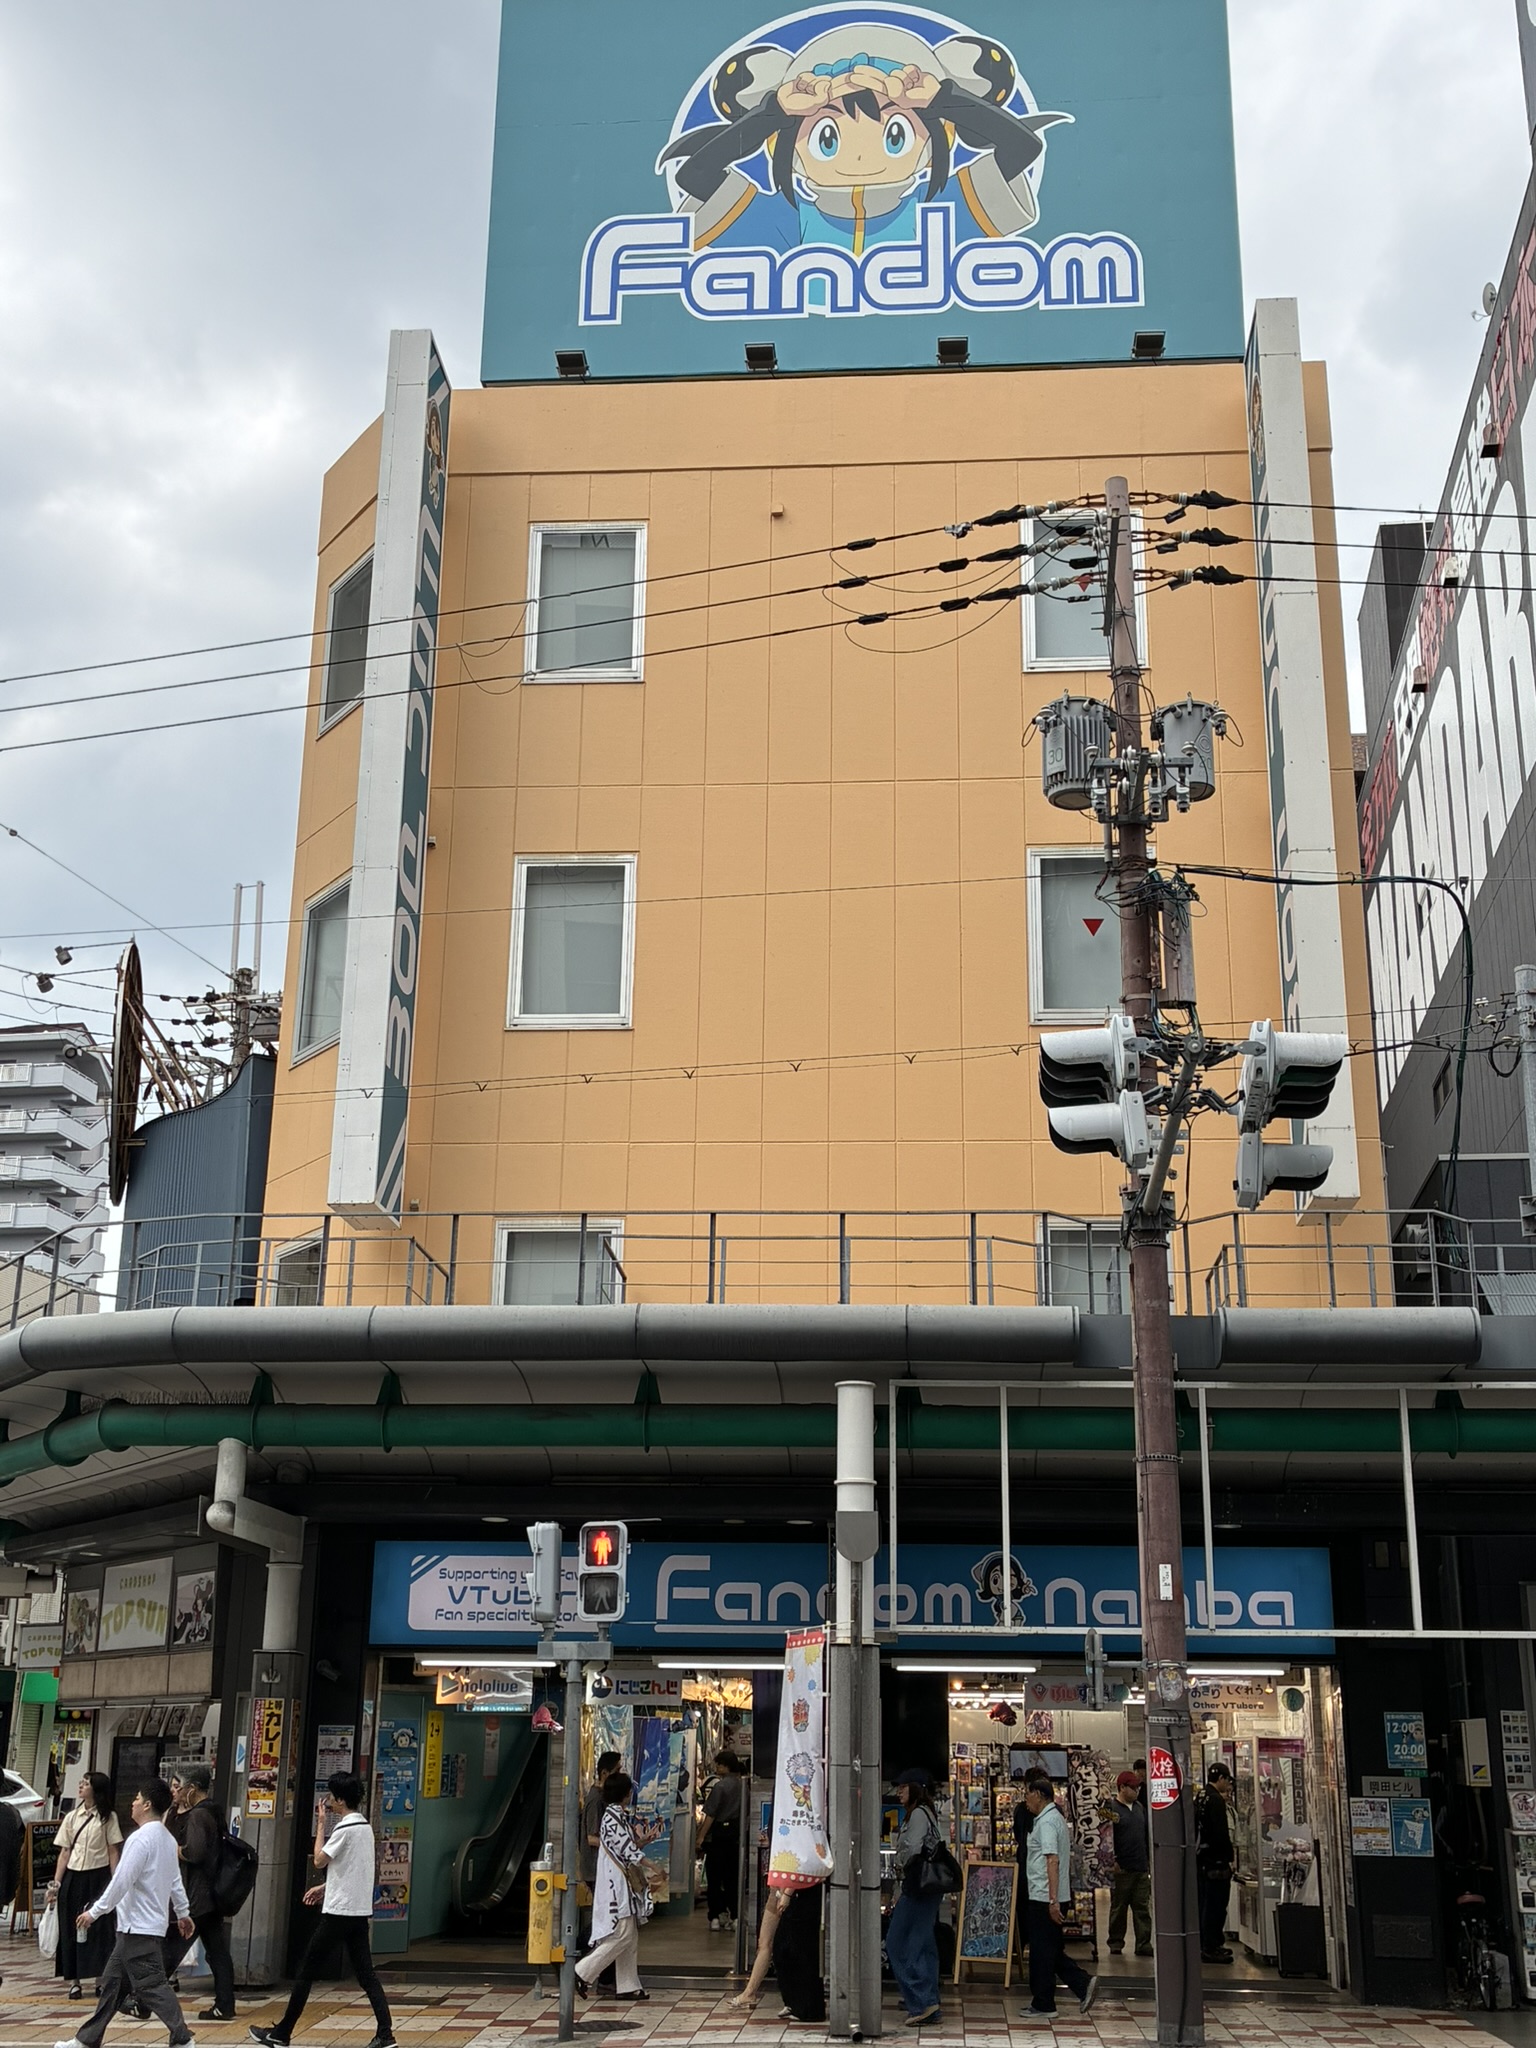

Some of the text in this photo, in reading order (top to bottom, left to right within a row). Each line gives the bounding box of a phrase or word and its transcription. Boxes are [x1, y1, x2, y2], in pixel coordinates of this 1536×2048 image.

[580, 203, 1144, 325] Fandom
[1048, 748, 1063, 764] 30
[119, 1573, 157, 1591] CARDSHOP
[439, 1568, 517, 1583] Supporting
[1045, 1577, 1295, 1626] Naba
[435, 1608, 463, 1621] Fan
[27, 1634, 62, 1642] CARDSHO
[461, 1679, 518, 1693] hololive
[616, 1680, 677, 1695] にじさんじ
[1193, 1701, 1220, 1709] Other
[265, 1711, 281, 1753] カレー
[1387, 1722, 1415, 1733] 12:00
[1394, 1744, 1424, 1756] 20:00
[1369, 1781, 1413, 1792] 岡田ビル
